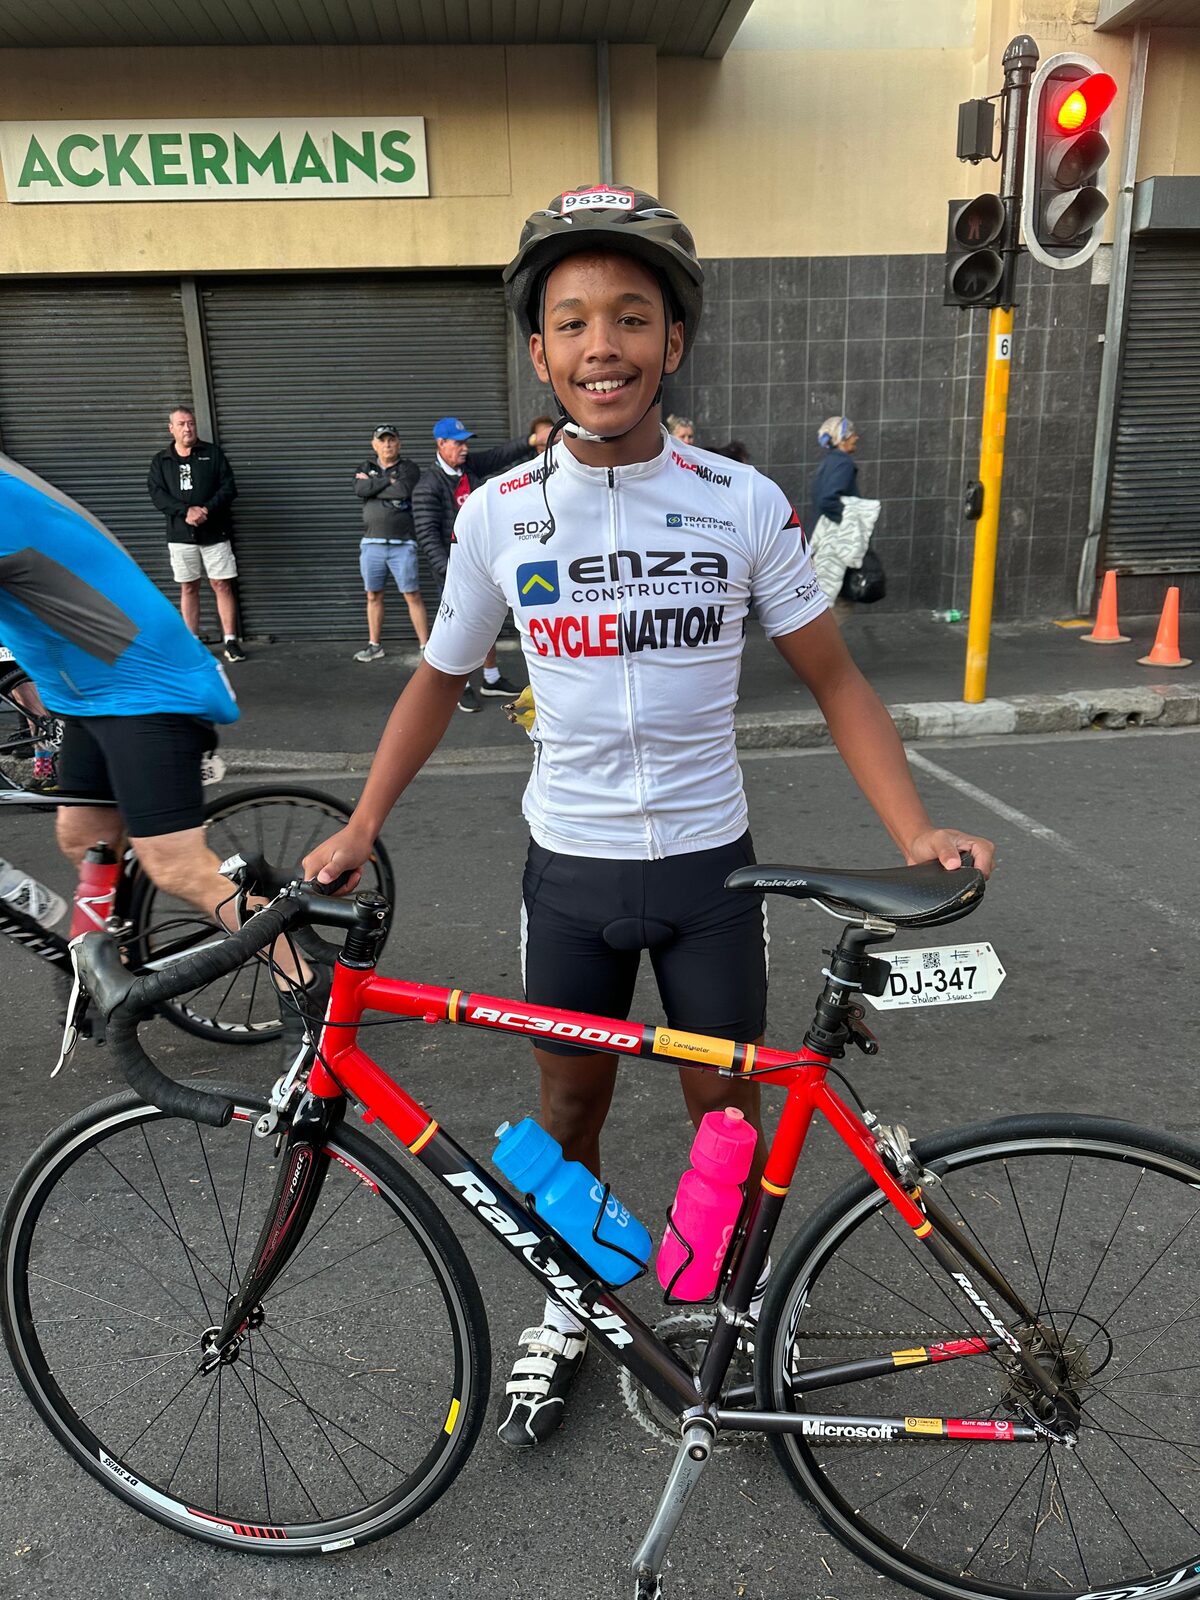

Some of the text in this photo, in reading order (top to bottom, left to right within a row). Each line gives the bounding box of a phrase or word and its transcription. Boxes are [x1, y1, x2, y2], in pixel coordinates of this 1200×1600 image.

[17, 129, 416, 188] ACKERMANS
[565, 194, 631, 207] 95320
[1001, 338, 1009, 356] 6
[513, 519, 553, 536] SOX
[568, 549, 729, 585] enza
[571, 580, 729, 603] CONSTRUCTION
[529, 605, 726, 659] CYCLENATION
[753, 879, 808, 888] Raleigh
[889, 965, 978, 997] DJ-347
[471, 1006, 640, 1048] RC3000
[802, 1420, 895, 1439] Microsoft
[102, 1457, 139, 1487] DT SWISS
